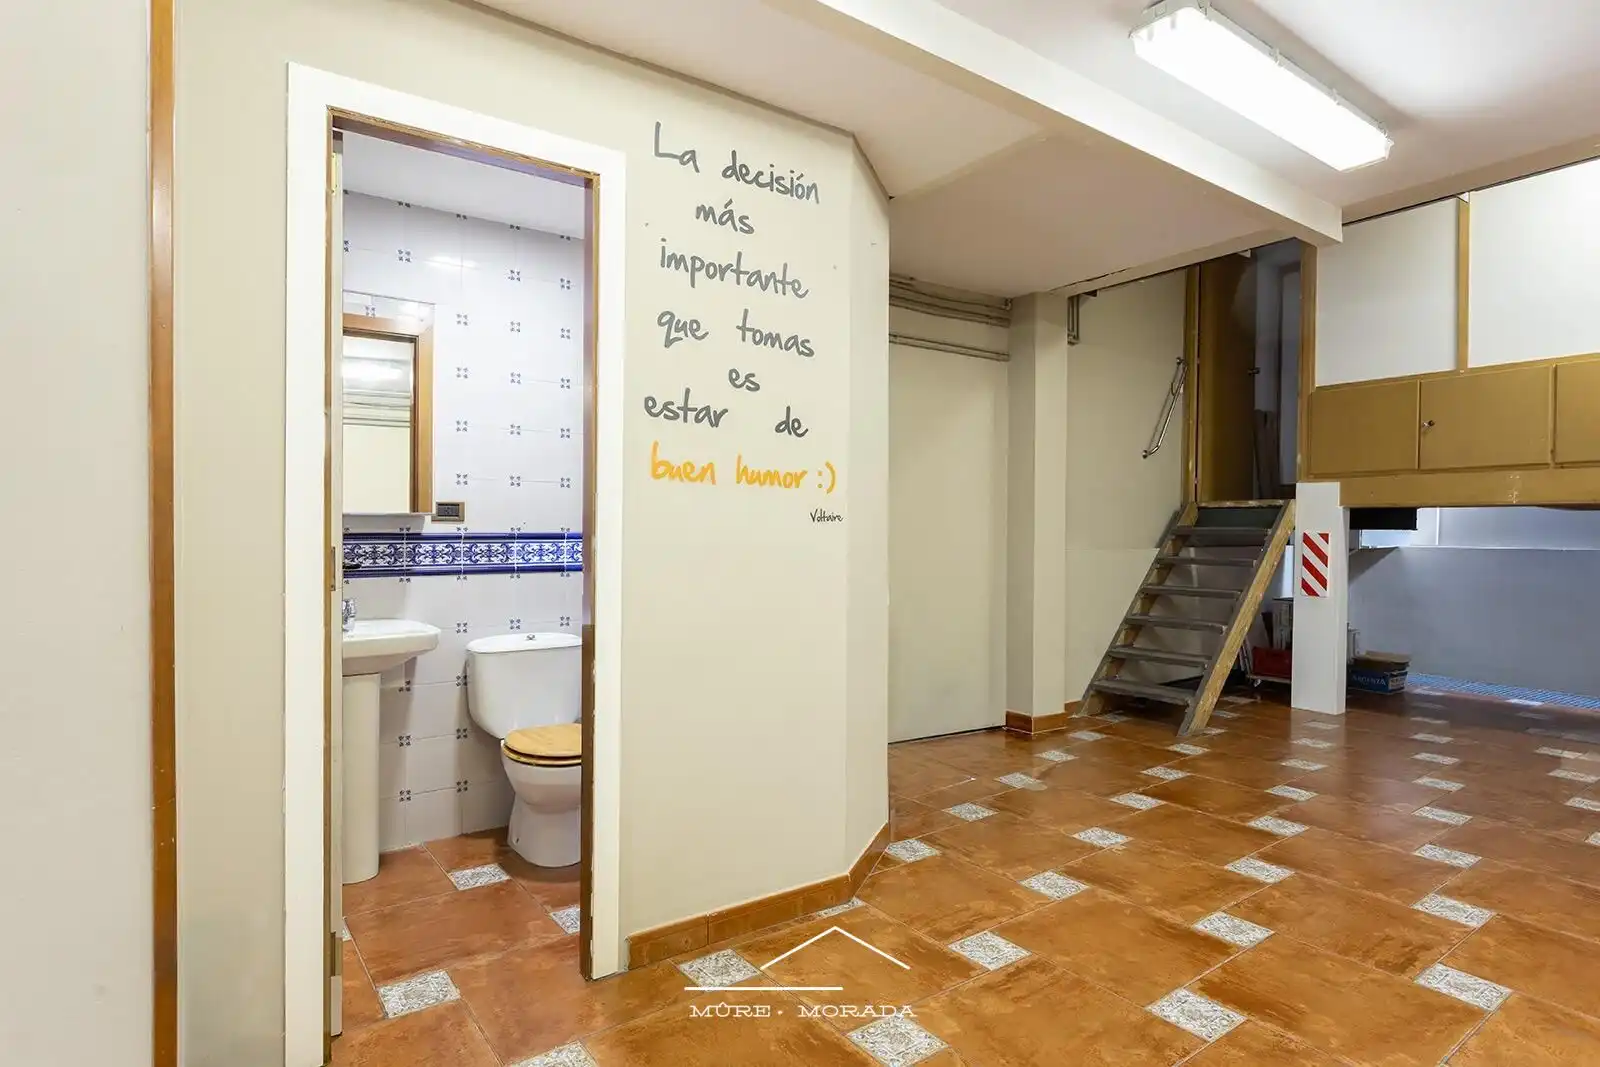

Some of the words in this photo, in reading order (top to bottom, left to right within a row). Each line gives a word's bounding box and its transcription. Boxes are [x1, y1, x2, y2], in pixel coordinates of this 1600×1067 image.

[654, 121, 700, 173] La
[721, 149, 819, 204] decisión
[695, 198, 754, 234] más
[660, 237, 809, 299] importante
[657, 310, 709, 349] que
[735, 308, 815, 358] tomas
[728, 368, 761, 392] es
[644, 387, 729, 428] estar
[774, 405, 808, 438] de
[650, 440, 717, 486] buen
[735, 453, 808, 489] humor
[809, 508, 844, 523] Voltaire
